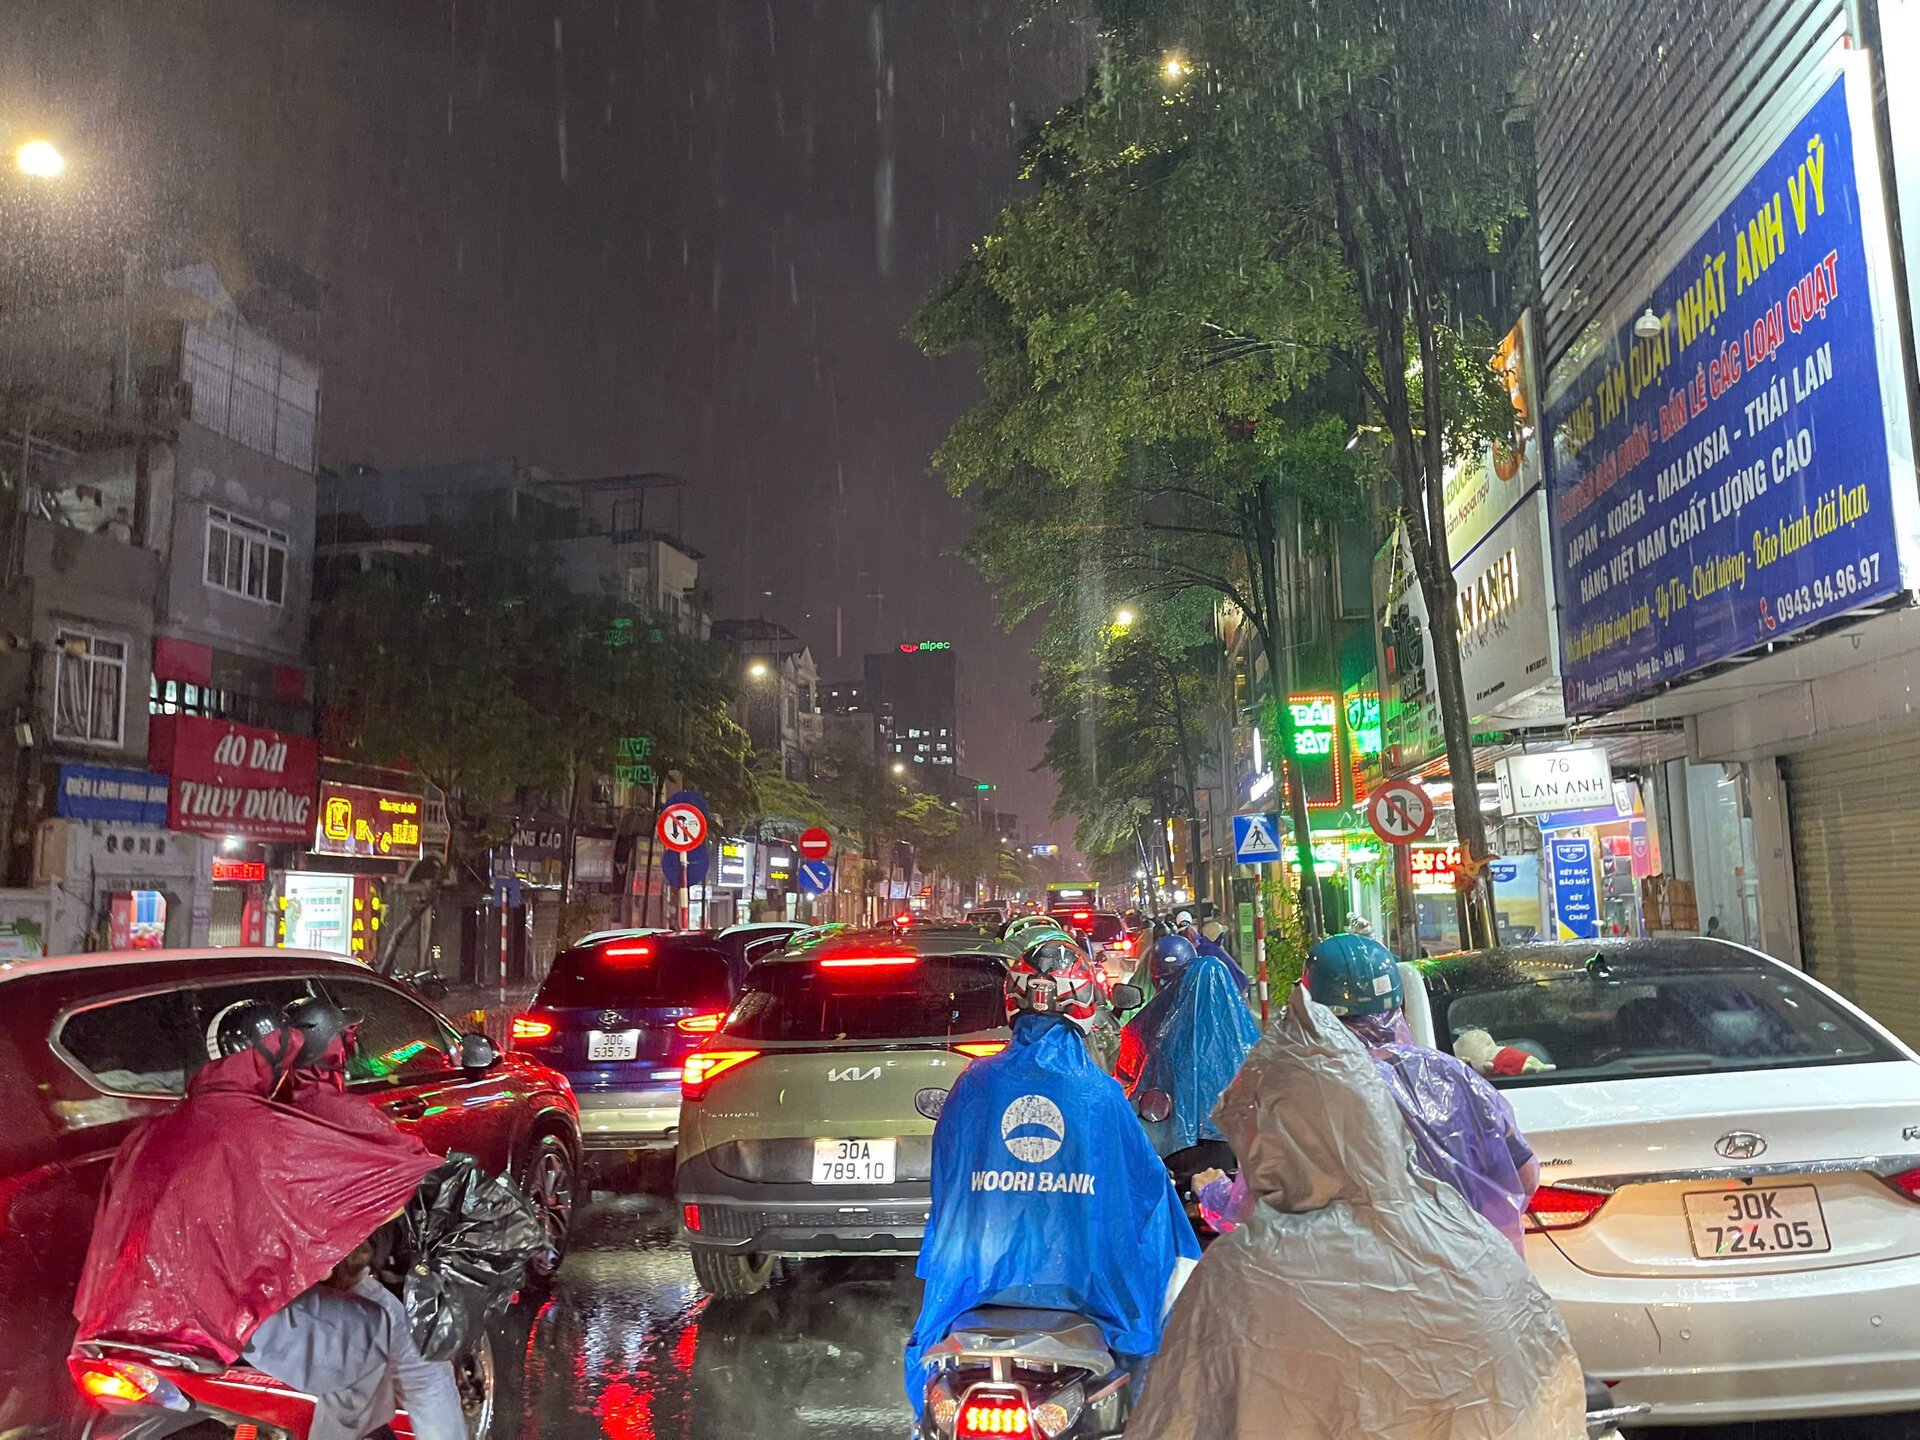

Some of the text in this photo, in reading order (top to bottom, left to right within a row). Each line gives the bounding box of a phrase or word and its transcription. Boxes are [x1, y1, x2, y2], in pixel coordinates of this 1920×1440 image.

[1676, 251, 1726, 352] NHẬT
[1736, 192, 1785, 296] ANH
[1787, 134, 1824, 235] VỸ
[1709, 340, 1742, 400] CÁC
[1744, 301, 1785, 372] LOẠI
[1787, 249, 1838, 335] QUẠT
[1568, 524, 1599, 568] JAPAN
[1607, 489, 1645, 539] KOREA
[1657, 424, 1730, 503] MALAYSIA
[1744, 374, 1788, 438] THÁI
[1793, 341, 1833, 404] LAN
[1580, 428, 1812, 605] HÀNG VIỆT NAM CHẤT LƯỢNG CAO
[1753, 526, 1779, 570] Bảo
[1779, 505, 1813, 558] hành
[1813, 488, 1838, 540] dài
[1838, 483, 1870, 529] hạn
[1776, 552, 1881, 624] 0943.94.96.97
[920, 640, 950, 651] mipec
[1548, 757, 1570, 774] 76
[1497, 775, 1510, 800] 76
[1520, 778, 1604, 798] LAN ANH
[512, 819, 537, 848] ẢNG
[593, 1046, 631, 1058] 535.75
[604, 1034, 623, 1046] 30G
[827, 1066, 881, 1081] KIA
[838, 1142, 870, 1160] 30A
[822, 1162, 884, 1180] 789.10
[971, 1170, 1096, 1195] WOORI BANK
[1723, 1191, 1783, 1221] 30K
[1706, 1221, 1814, 1254] 724.05
